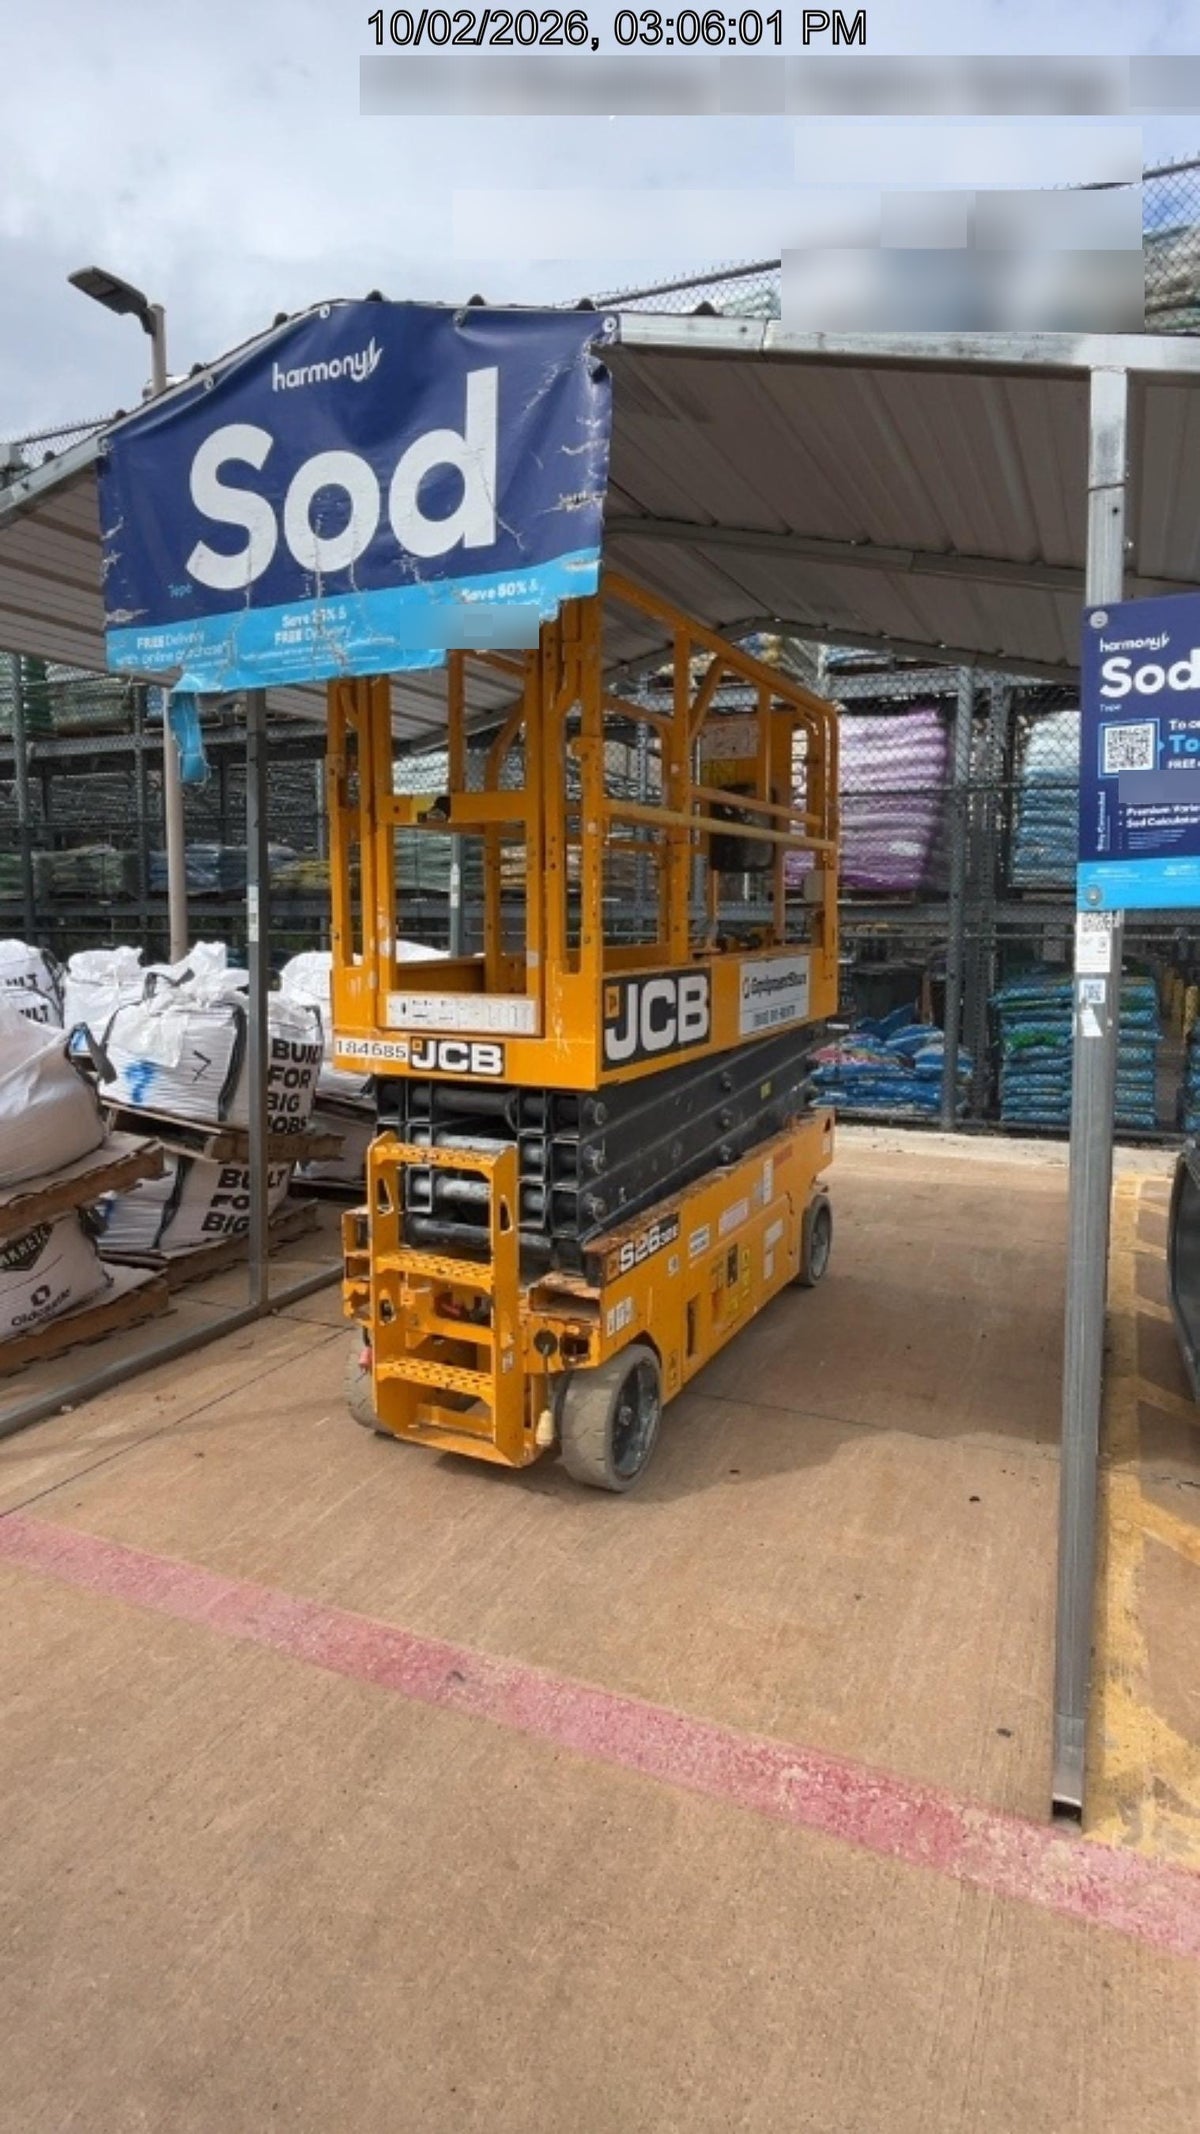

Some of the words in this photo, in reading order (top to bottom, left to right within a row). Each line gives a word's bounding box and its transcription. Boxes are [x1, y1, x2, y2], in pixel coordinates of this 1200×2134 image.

[271, 338, 372, 392] harmony
[185, 366, 499, 590] Sod
[136, 634, 165, 649] FREE
[1099, 648, 1200, 698] Sod
[604, 974, 710, 1061] JCB
[336, 1039, 408, 1059] 184685
[411, 1038, 504, 1076] JCB
